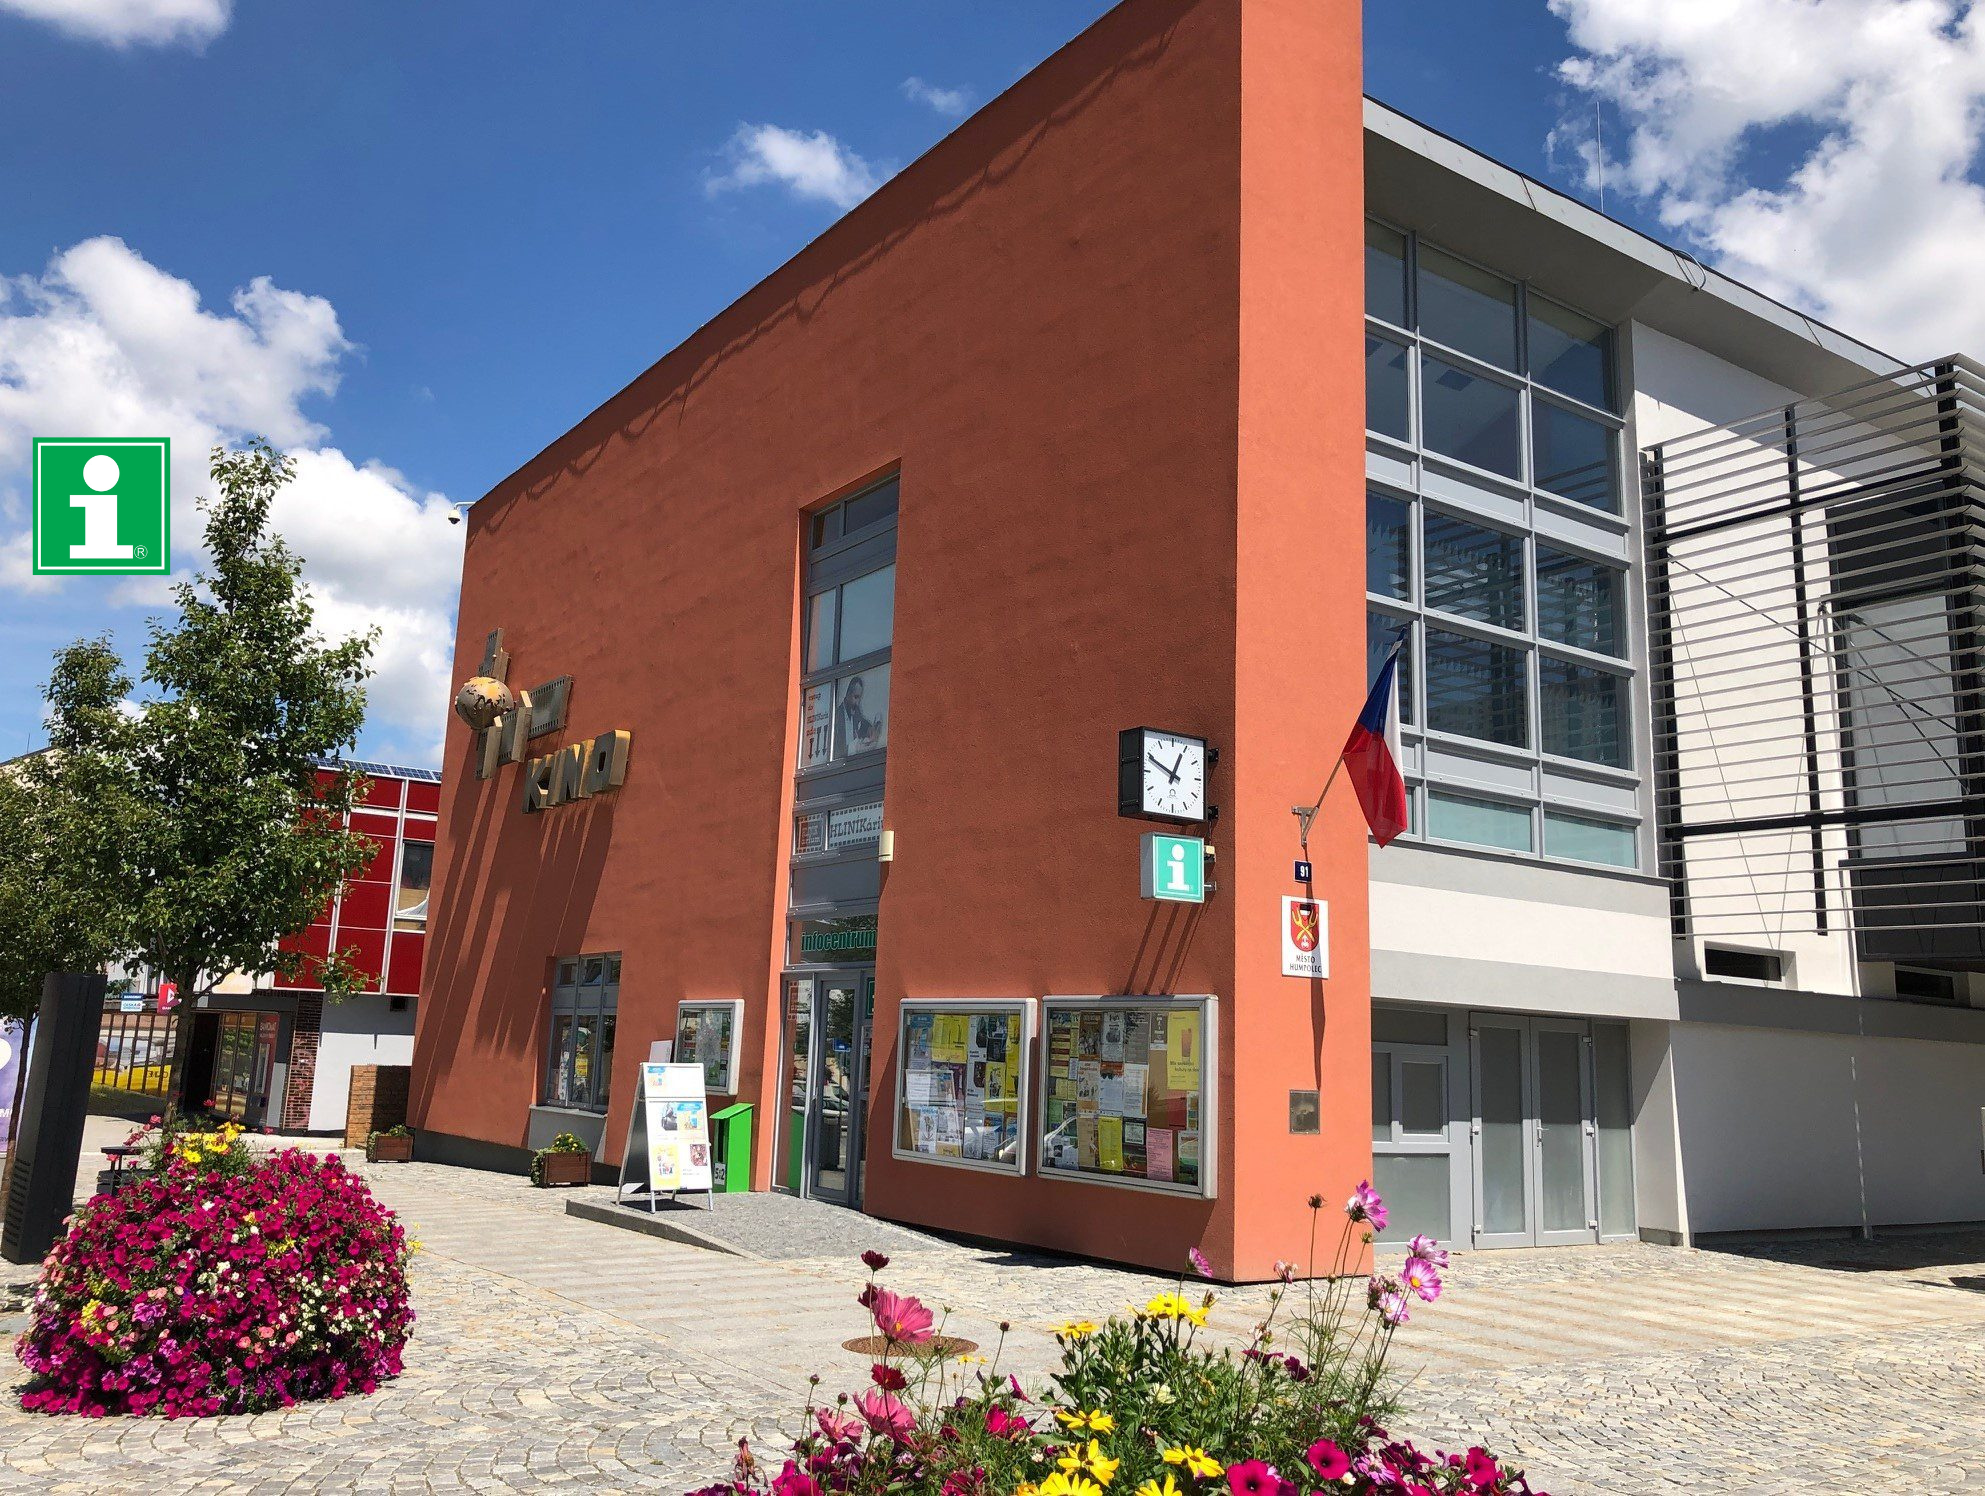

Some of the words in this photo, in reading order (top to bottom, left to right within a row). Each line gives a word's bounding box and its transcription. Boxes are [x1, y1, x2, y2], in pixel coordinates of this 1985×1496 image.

[521, 729, 631, 815] KINO
[1300, 865, 1309, 878] 91
[801, 930, 877, 952] infocentrum
[1295, 953, 1316, 964] MĚSTO
[1289, 964, 1322, 974] HUMPOLEC
